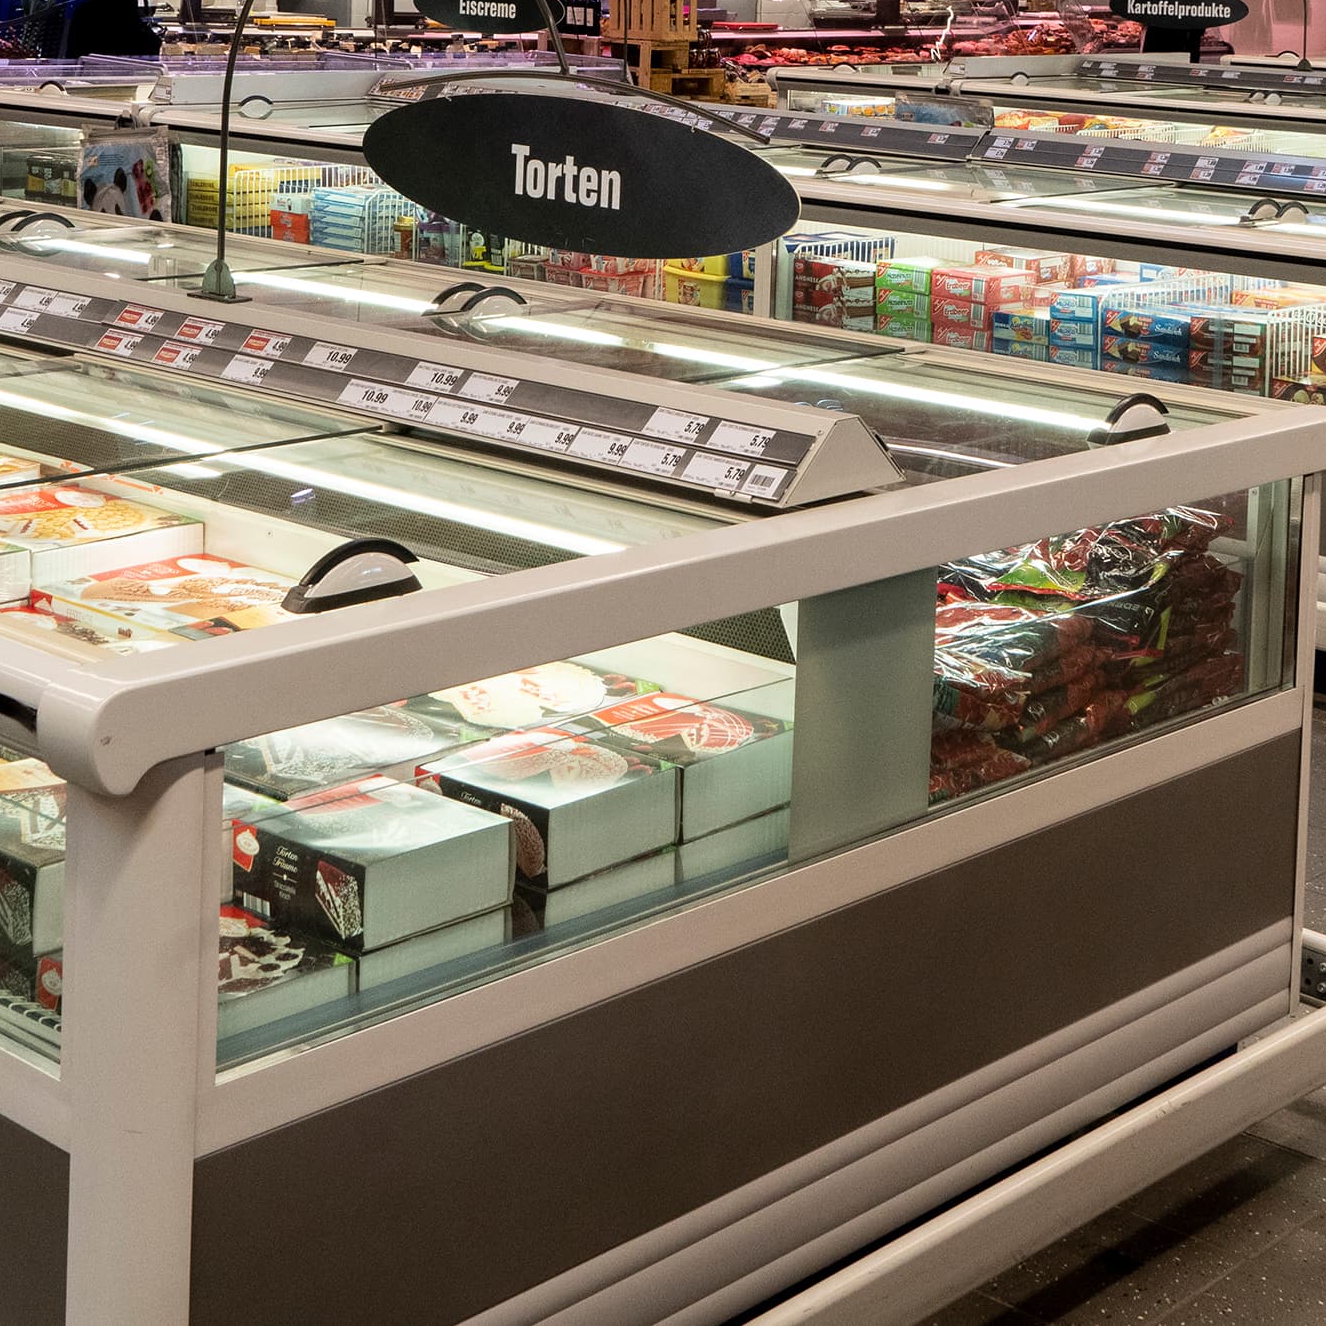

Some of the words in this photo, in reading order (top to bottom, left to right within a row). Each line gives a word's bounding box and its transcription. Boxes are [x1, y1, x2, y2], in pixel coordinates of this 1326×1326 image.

[1127, 0, 1231, 19] Kartoffelprodukte
[511, 143, 621, 210] Torten
[795, 275, 819, 284] ANGNESE
[326, 350, 353, 365] 10.99
[431, 371, 459, 387] 10.99
[361, 389, 390, 404] 10.99
[494, 383, 513, 397] 9.99
[411, 399, 433, 414] 10.99
[459, 412, 479, 425] 9.99
[506, 422, 526, 436] 9.99
[684, 421, 706, 435] 5.79
[554, 431, 576, 446] 9.99
[749, 435, 771, 449] 5.79
[607, 442, 628, 457] 9.99
[660, 453, 682, 467] 5.79
[724, 466, 746, 481] 5.79
[276, 845, 299, 862] Torten
